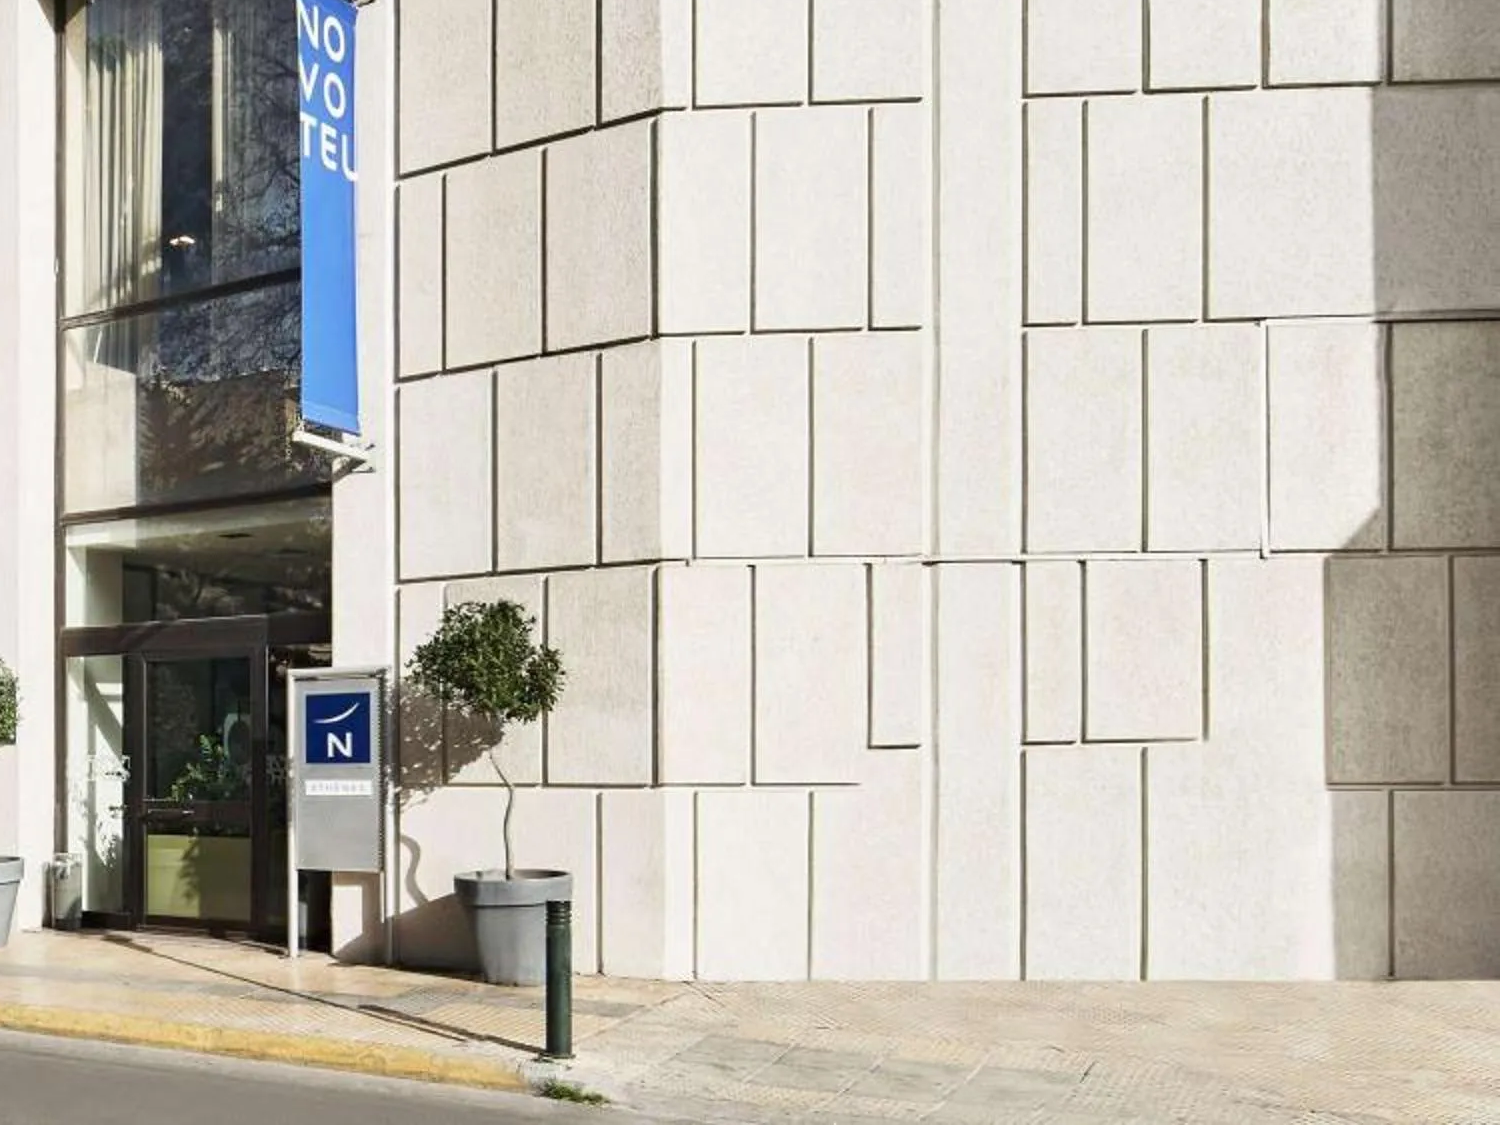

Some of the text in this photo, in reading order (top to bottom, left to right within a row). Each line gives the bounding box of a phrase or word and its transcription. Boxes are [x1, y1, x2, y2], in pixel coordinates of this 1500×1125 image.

[298, 53, 346, 118] VO
[300, 112, 358, 181] TEL
[327, 732, 353, 758] N
